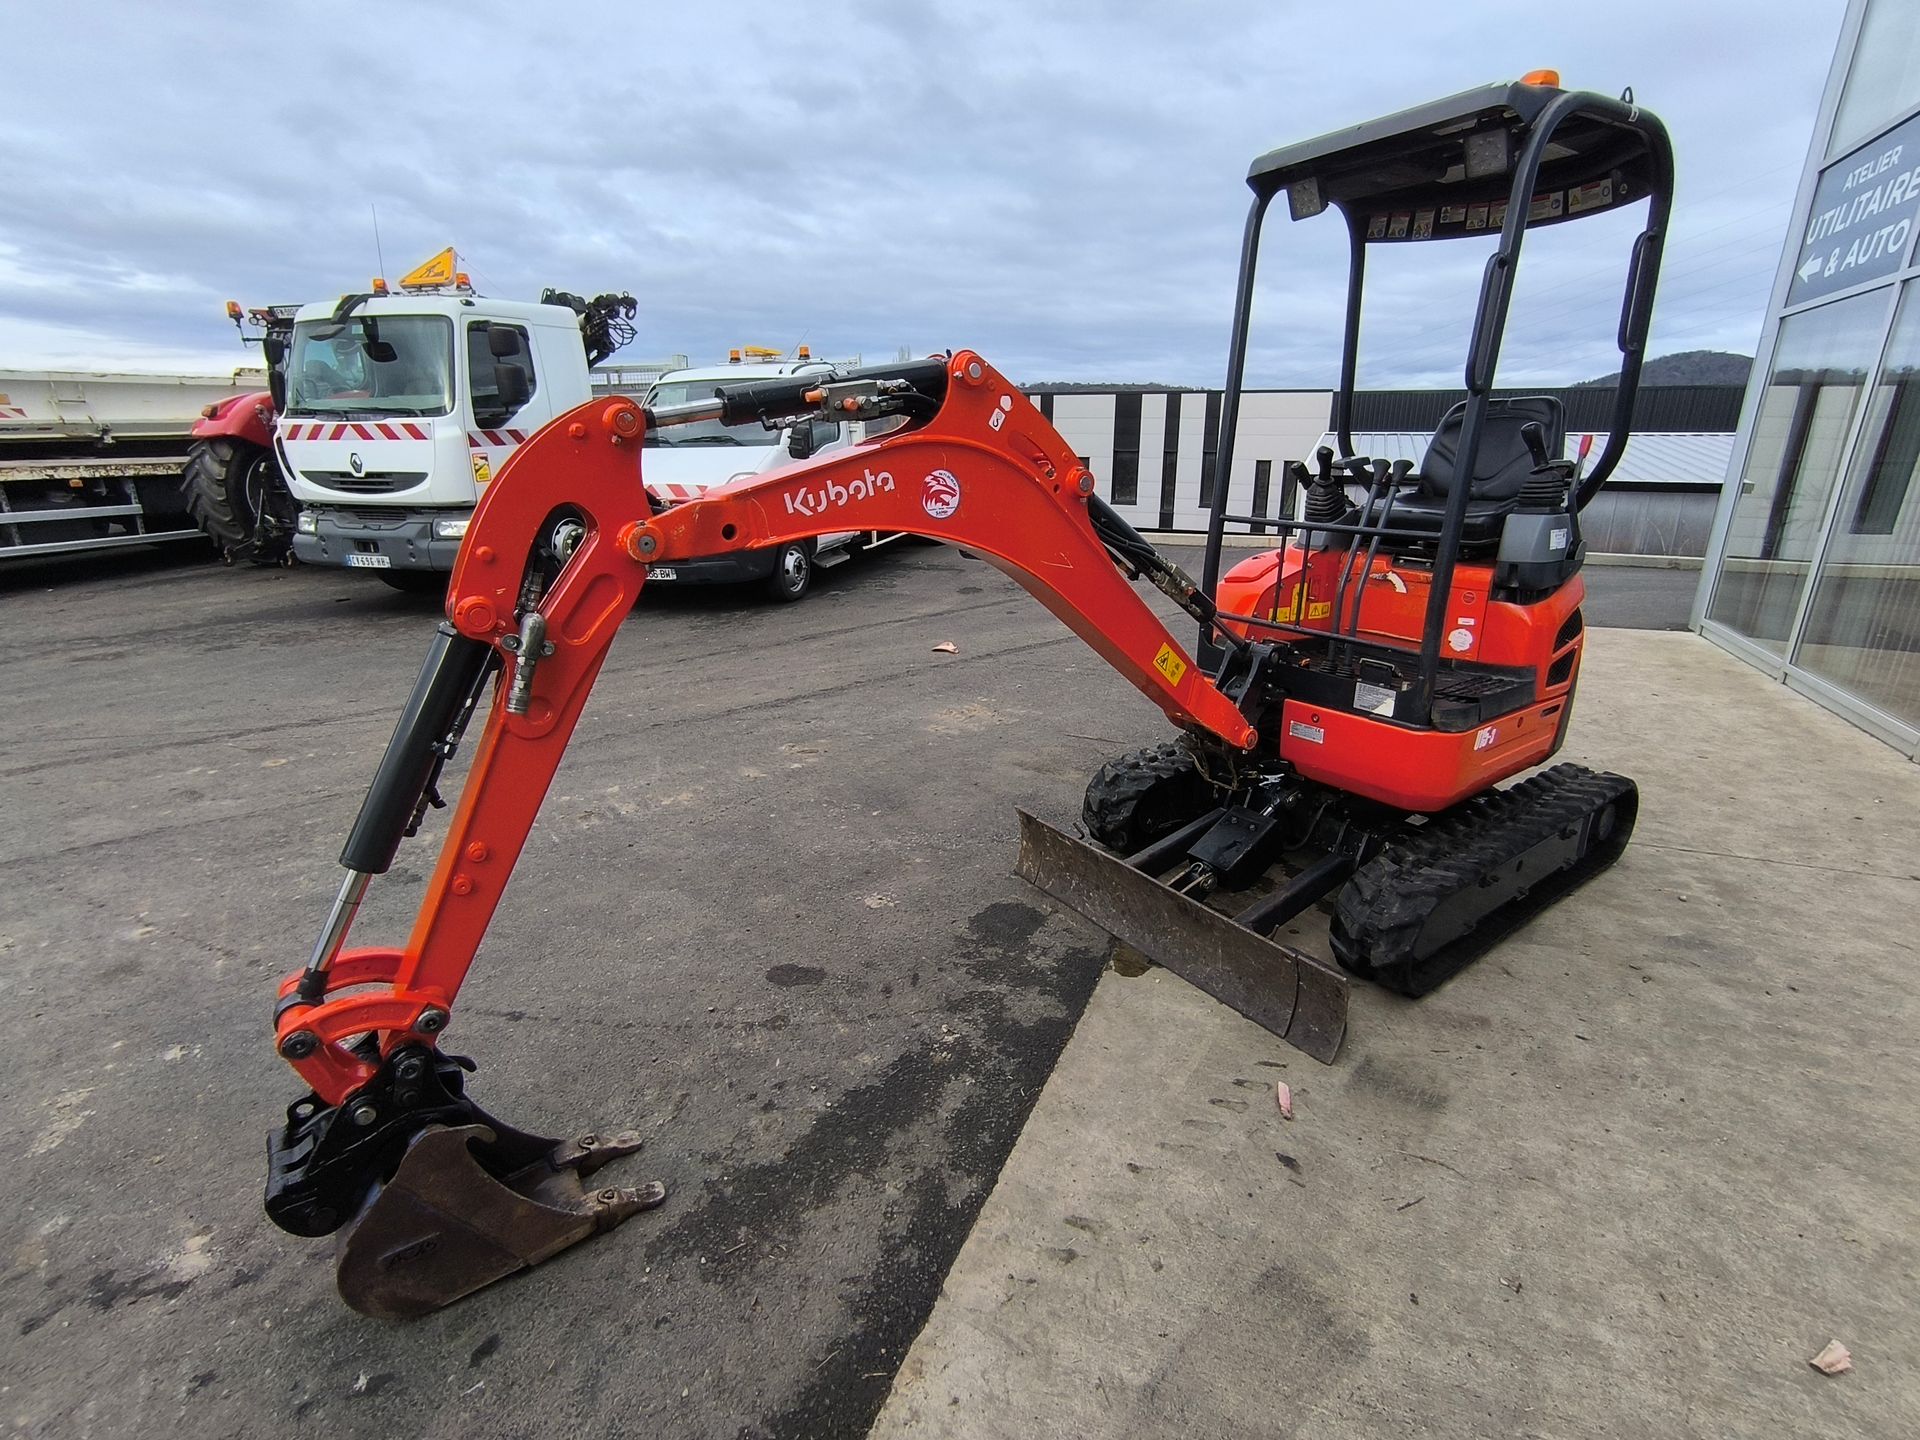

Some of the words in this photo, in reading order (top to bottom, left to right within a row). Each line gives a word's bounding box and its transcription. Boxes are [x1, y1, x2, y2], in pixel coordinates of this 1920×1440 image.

[1842, 145, 1903, 192] ATELIER
[1824, 247, 1841, 277] &
[1840, 218, 1911, 271] AUTO
[784, 468, 895, 516] Kubota
